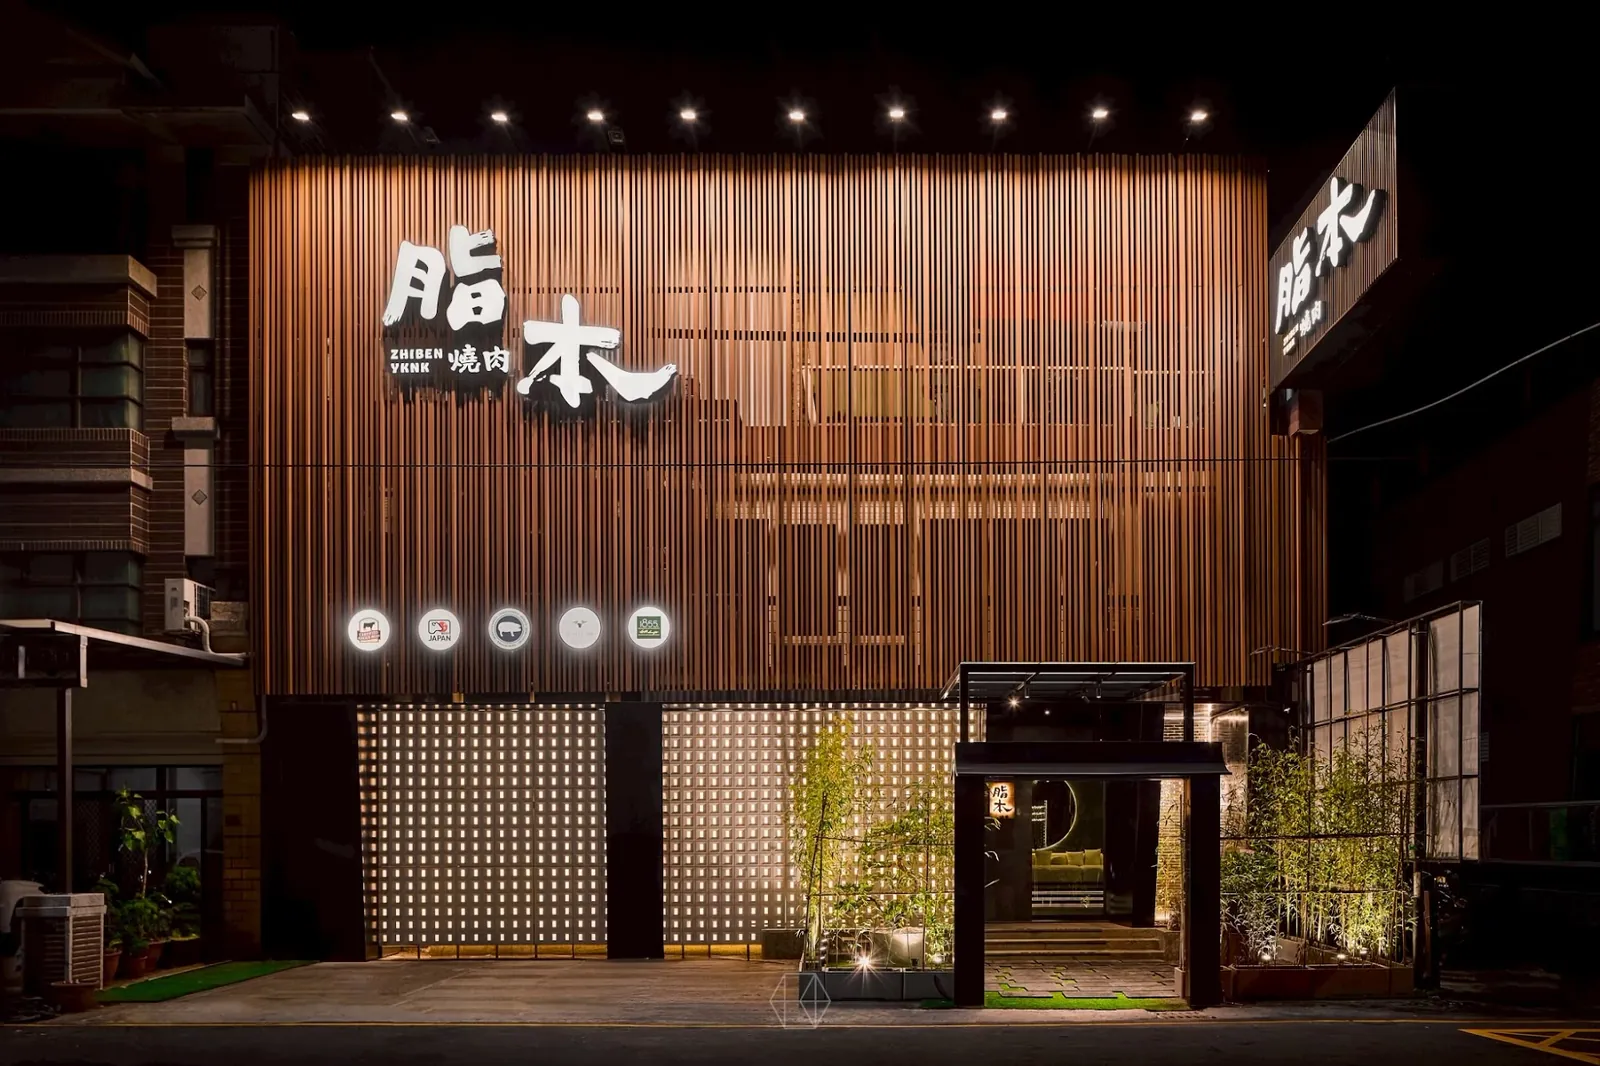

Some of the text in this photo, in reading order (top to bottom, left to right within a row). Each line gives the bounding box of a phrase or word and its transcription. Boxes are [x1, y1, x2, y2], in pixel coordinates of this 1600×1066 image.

[1275, 177, 1376, 334] 脂本
[382, 224, 677, 408] 脂本
[390, 348, 443, 360] ZHIBEN
[390, 362, 430, 374] YKNK
[448, 343, 510, 374] 燒肉
